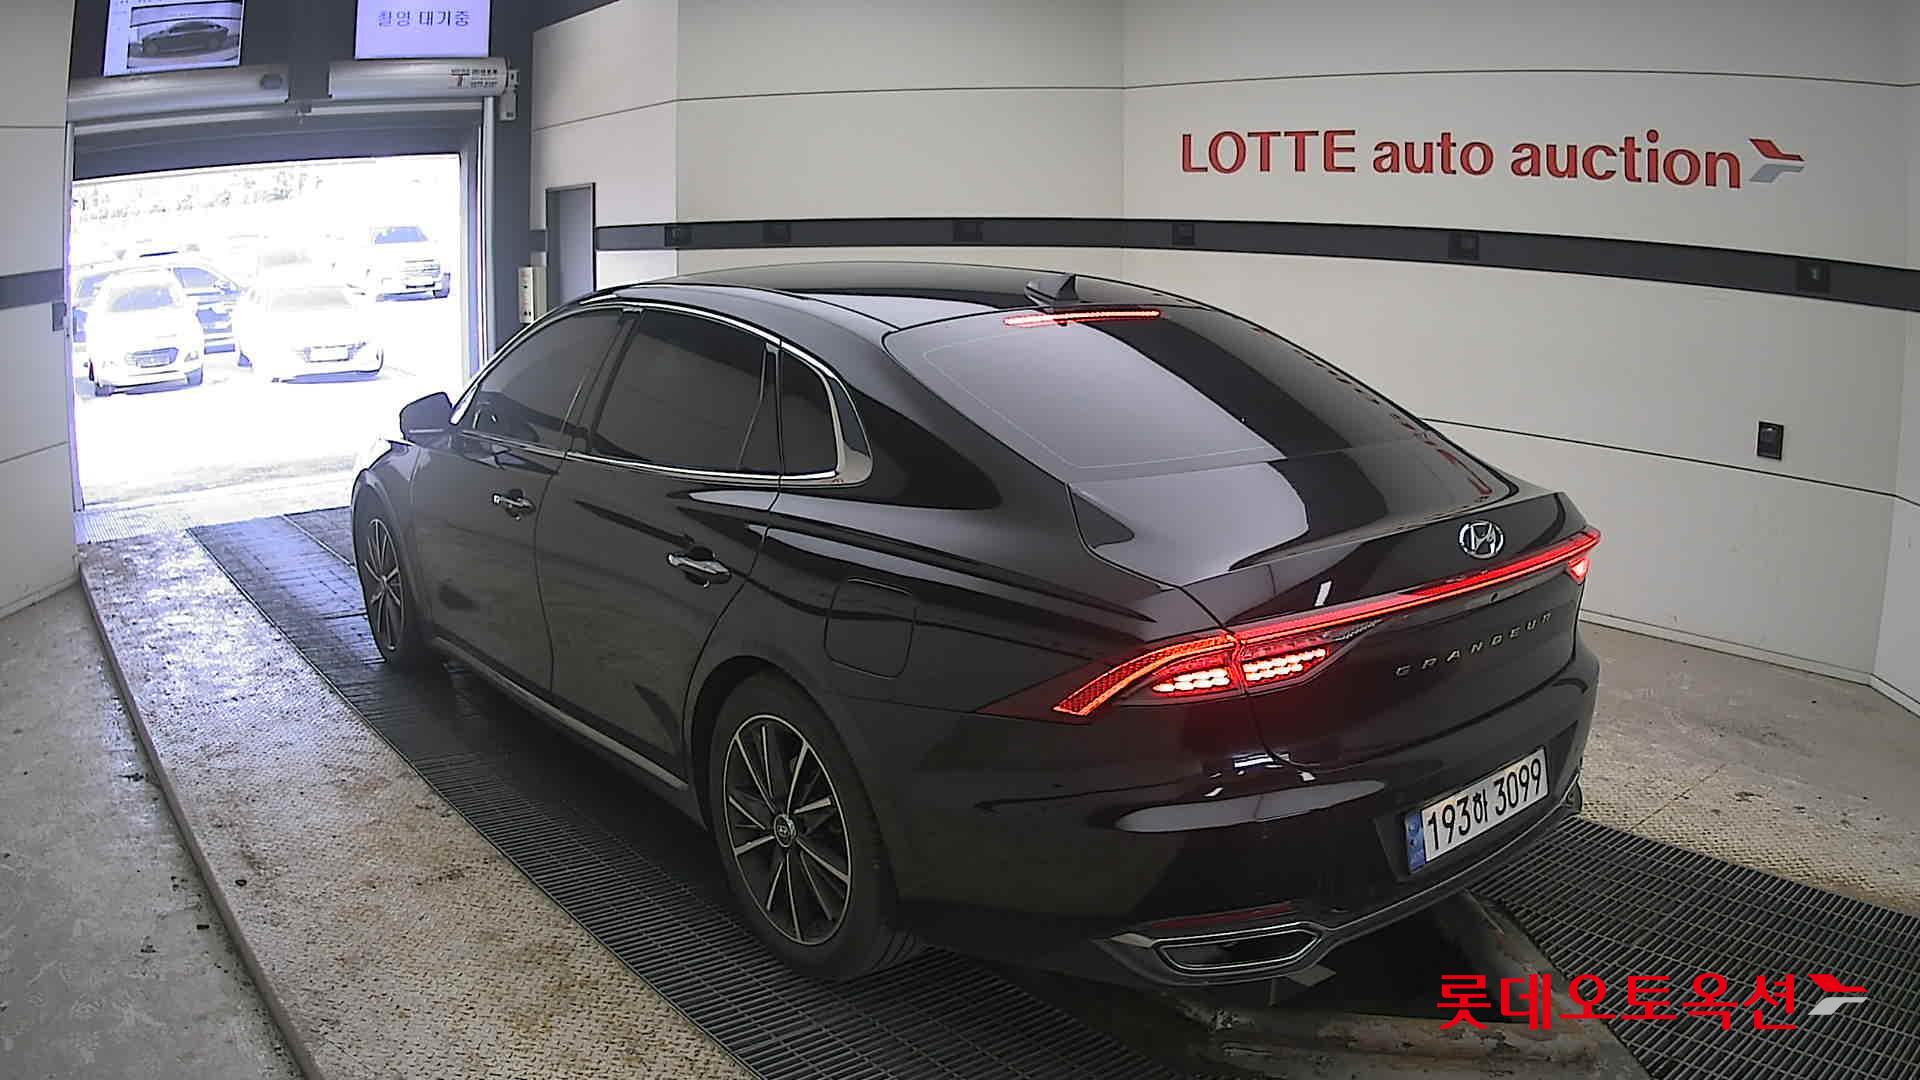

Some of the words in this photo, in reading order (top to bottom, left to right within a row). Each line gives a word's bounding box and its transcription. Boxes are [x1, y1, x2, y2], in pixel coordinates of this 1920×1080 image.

[418, 10, 469, 27] 대기중
[1181, 130, 1356, 174] LOTTE
[1373, 132, 1495, 176] auto
[1511, 129, 1741, 189] auction
[1395, 611, 1553, 677] GRANDEUR
[1428, 788, 1489, 851] 193하
[1493, 758, 1542, 816] 3099
